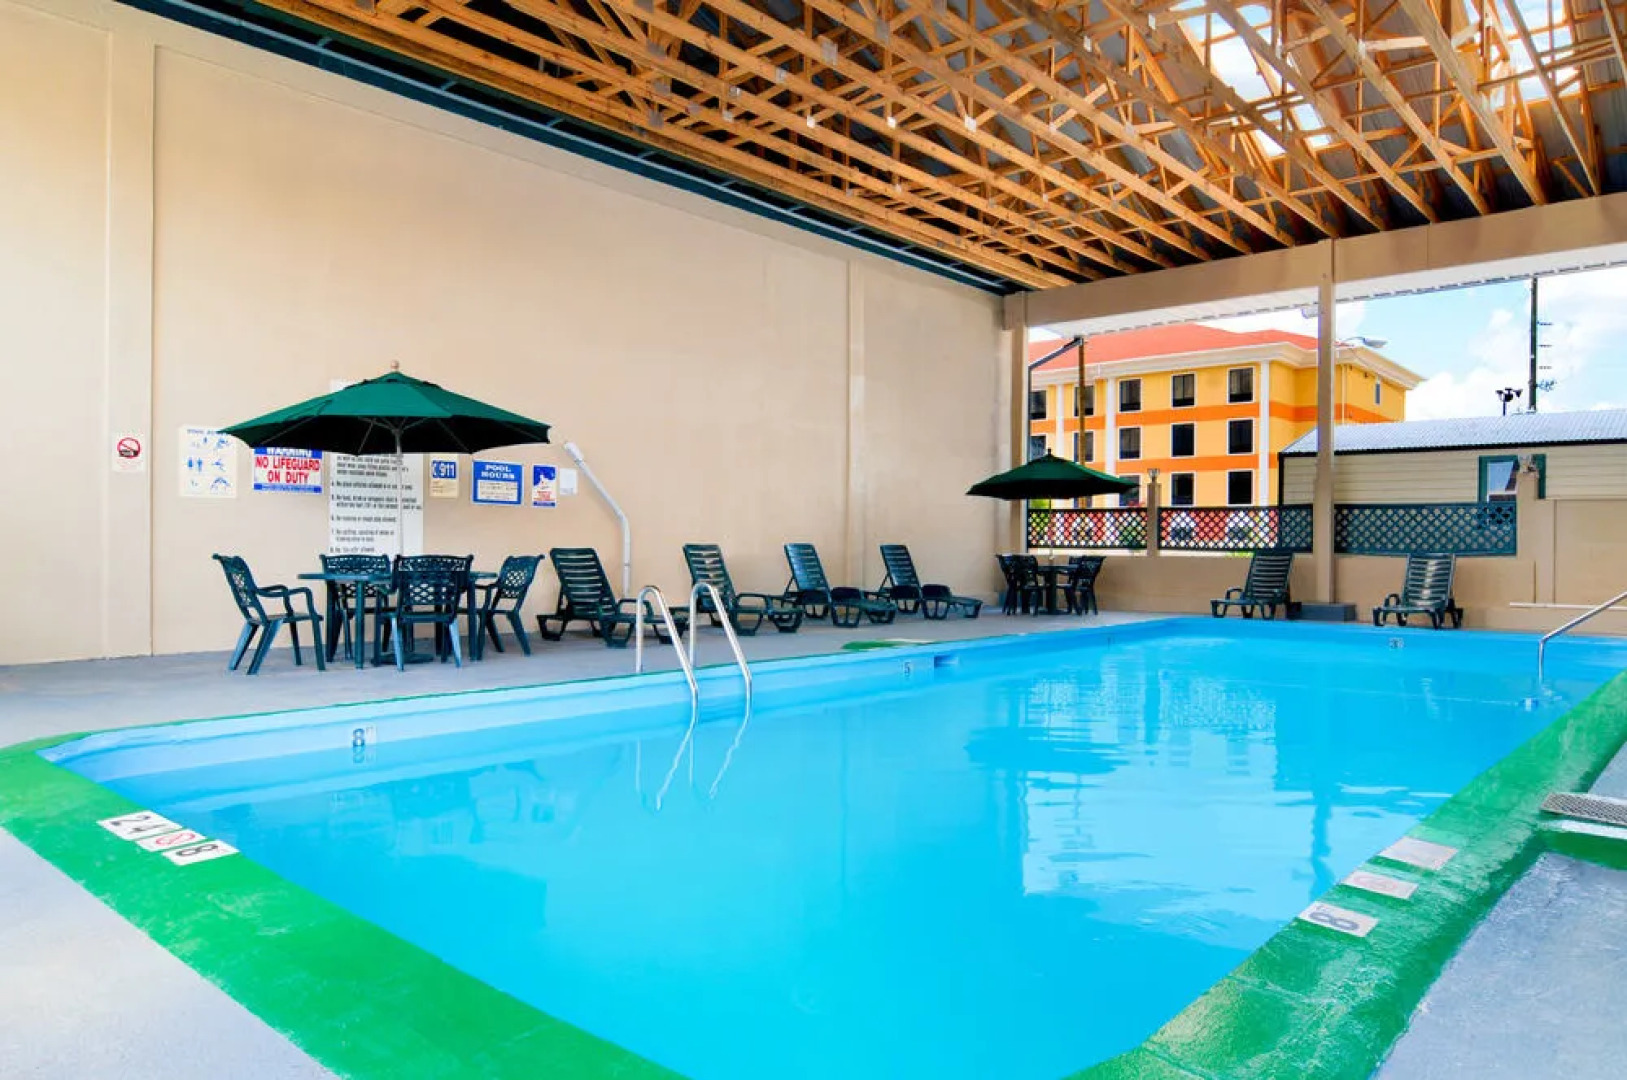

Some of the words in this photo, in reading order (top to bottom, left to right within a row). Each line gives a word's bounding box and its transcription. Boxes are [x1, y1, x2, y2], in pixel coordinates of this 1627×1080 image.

[256, 456, 269, 468] NO
[273, 457, 320, 471] LIFEGUARD
[439, 462, 455, 477] 911
[485, 464, 511, 473] POOL
[267, 470, 280, 483] ON
[286, 471, 309, 484] DUTY
[481, 471, 515, 479] HOURS
[353, 728, 365, 747] 8
[175, 843, 219, 857] 8
[1310, 911, 1358, 931] 8
